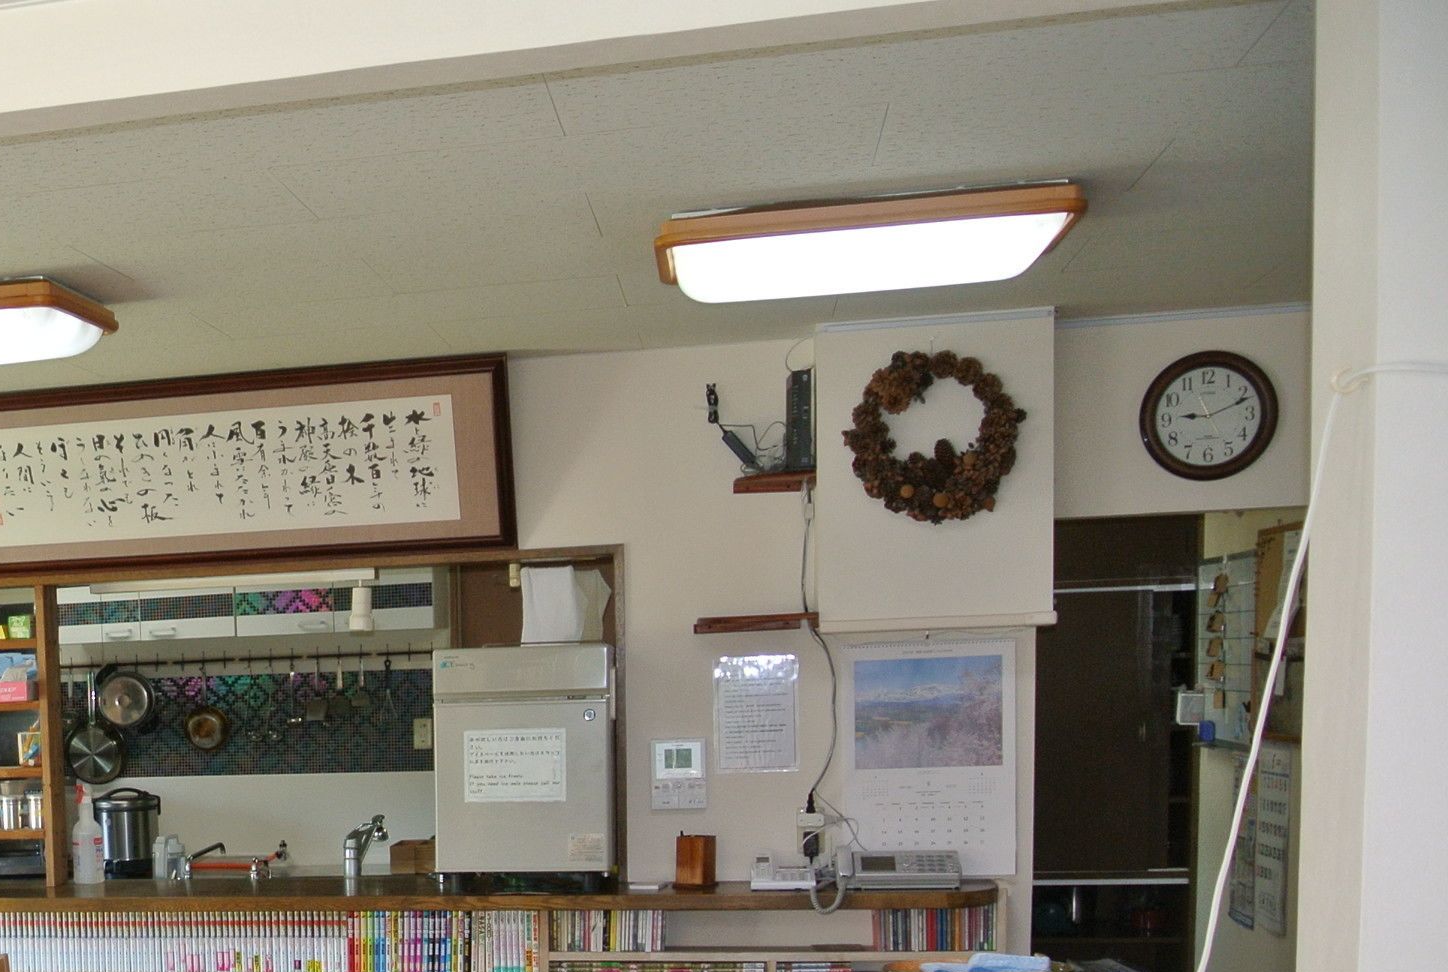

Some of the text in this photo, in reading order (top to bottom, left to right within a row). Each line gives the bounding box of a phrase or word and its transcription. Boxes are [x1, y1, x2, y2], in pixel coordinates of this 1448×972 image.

[1181, 377, 1193, 391] 11
[1201, 369, 1216, 385] 12
[1225, 374, 1231, 388] 1
[1165, 392, 1180, 408] 10
[1161, 413, 1172, 428] 9
[1245, 406, 1255, 421] 3
[1167, 431, 1178, 447] 8
[1238, 427, 1248, 441] 4
[1184, 445, 1193, 460] 7
[1203, 447, 1214, 463] 6
[1224, 441, 1234, 457] 5
